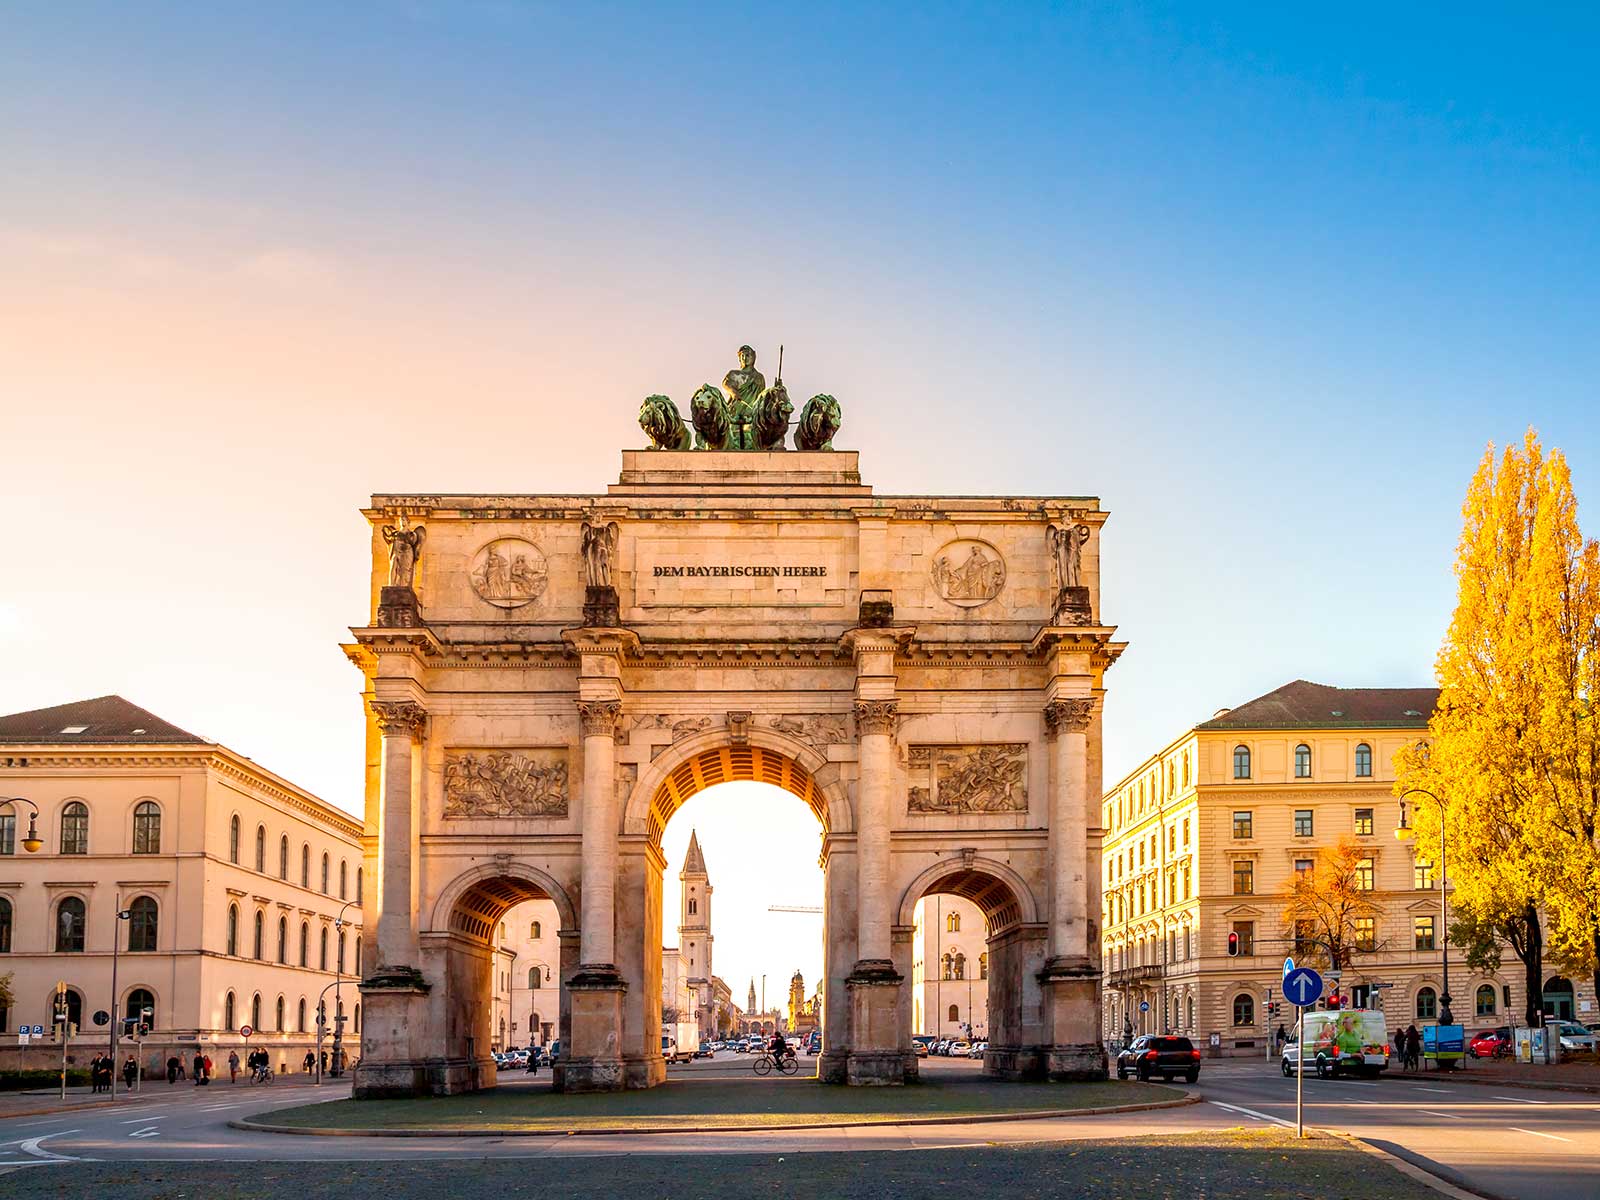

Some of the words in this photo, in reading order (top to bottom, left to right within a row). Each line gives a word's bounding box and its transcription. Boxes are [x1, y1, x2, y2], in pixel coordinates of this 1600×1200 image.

[653, 566, 684, 577] DEM
[686, 566, 780, 577] BAYERISCHEN
[782, 566, 827, 577] HEERE
